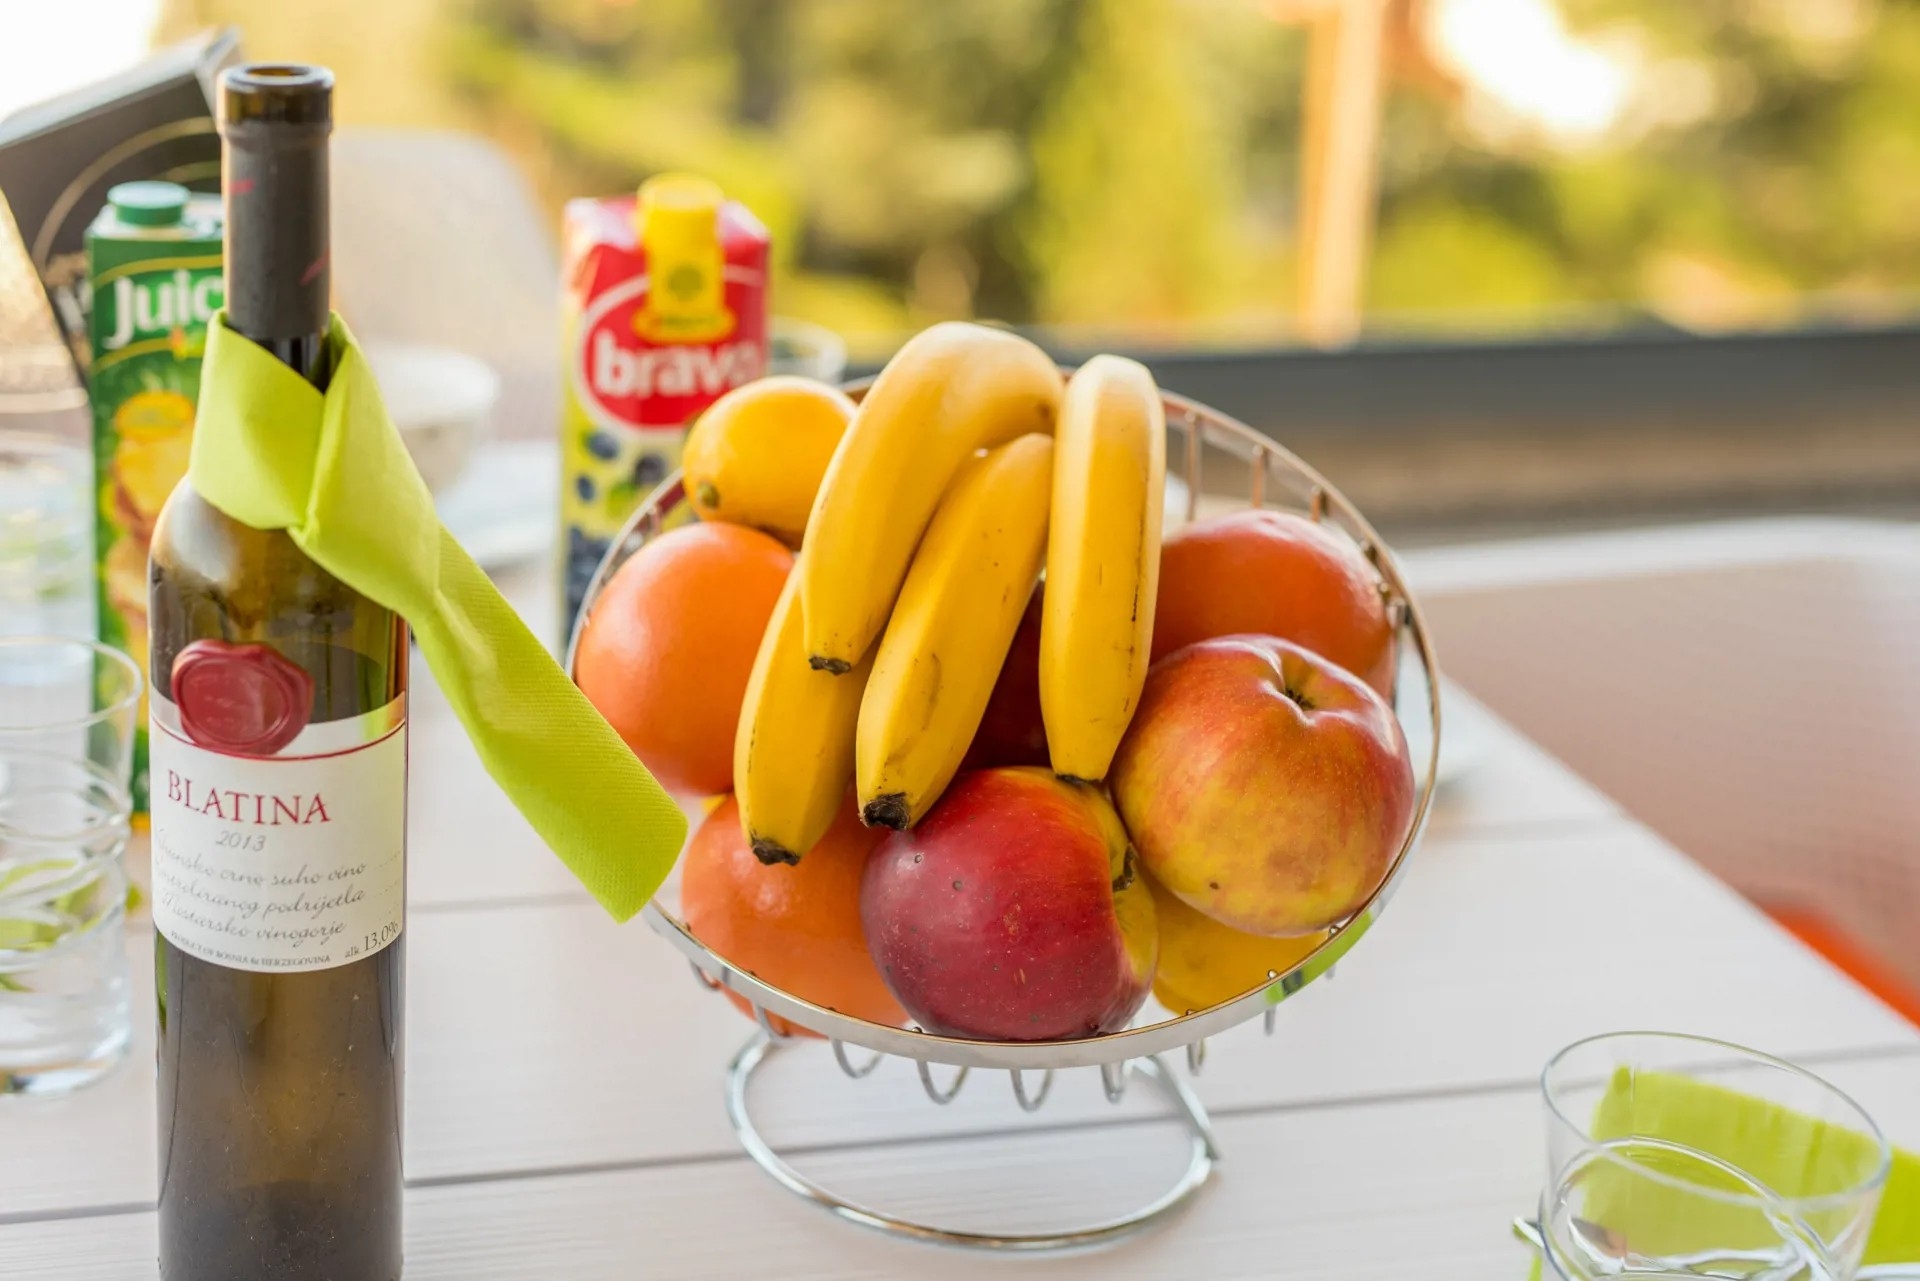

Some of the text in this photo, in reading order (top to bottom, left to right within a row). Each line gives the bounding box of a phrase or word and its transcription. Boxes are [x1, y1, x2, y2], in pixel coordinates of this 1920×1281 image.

[102, 268, 223, 349] Juic
[594, 328, 764, 398] bravo
[168, 769, 331, 825] BLATINA
[215, 829, 267, 852] 2013
[271, 864, 322, 886] suho
[328, 862, 367, 881] vino
[262, 882, 365, 921] podrijetla
[256, 919, 346, 949] vinogorje
[344, 919, 399, 959] alk 13,0%
[260, 953, 331, 968] HERZEGOVINA
